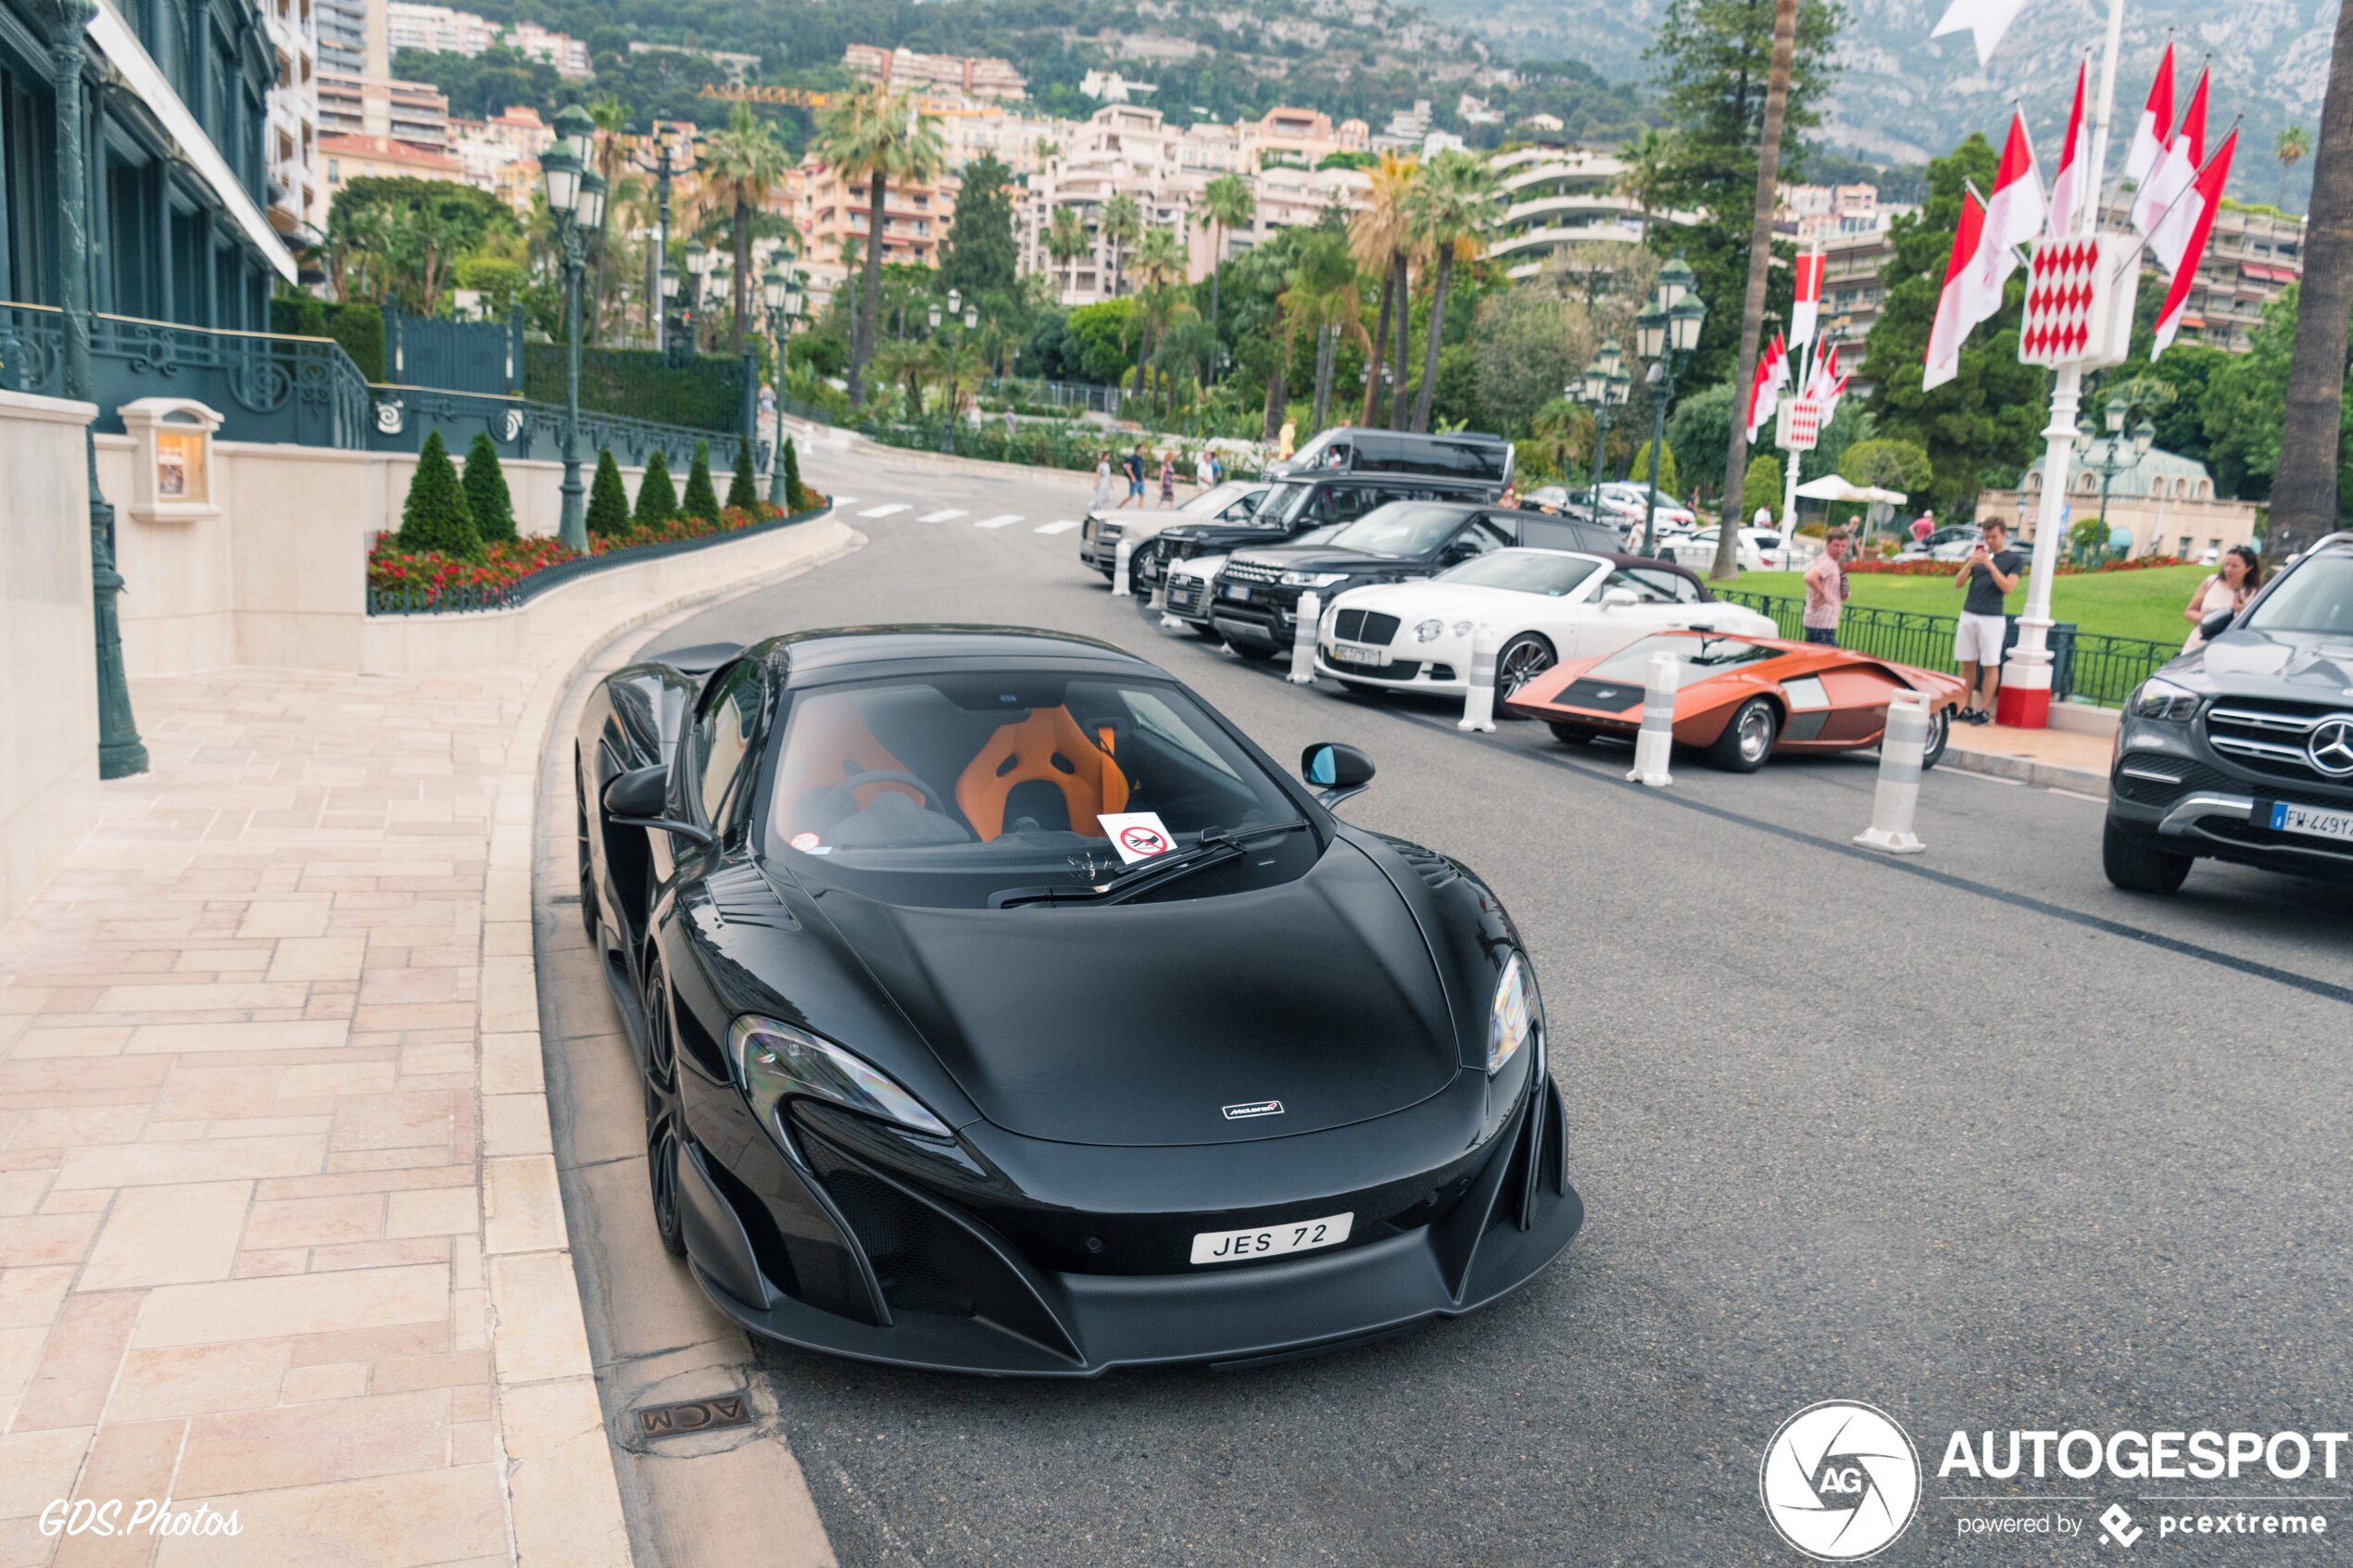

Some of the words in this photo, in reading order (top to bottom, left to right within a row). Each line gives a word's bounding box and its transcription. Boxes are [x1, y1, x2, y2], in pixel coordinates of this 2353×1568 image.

[1213, 1233, 1272, 1257] JES
[1292, 1224, 1327, 1247] 72
[642, 1399, 741, 1432] ACM
